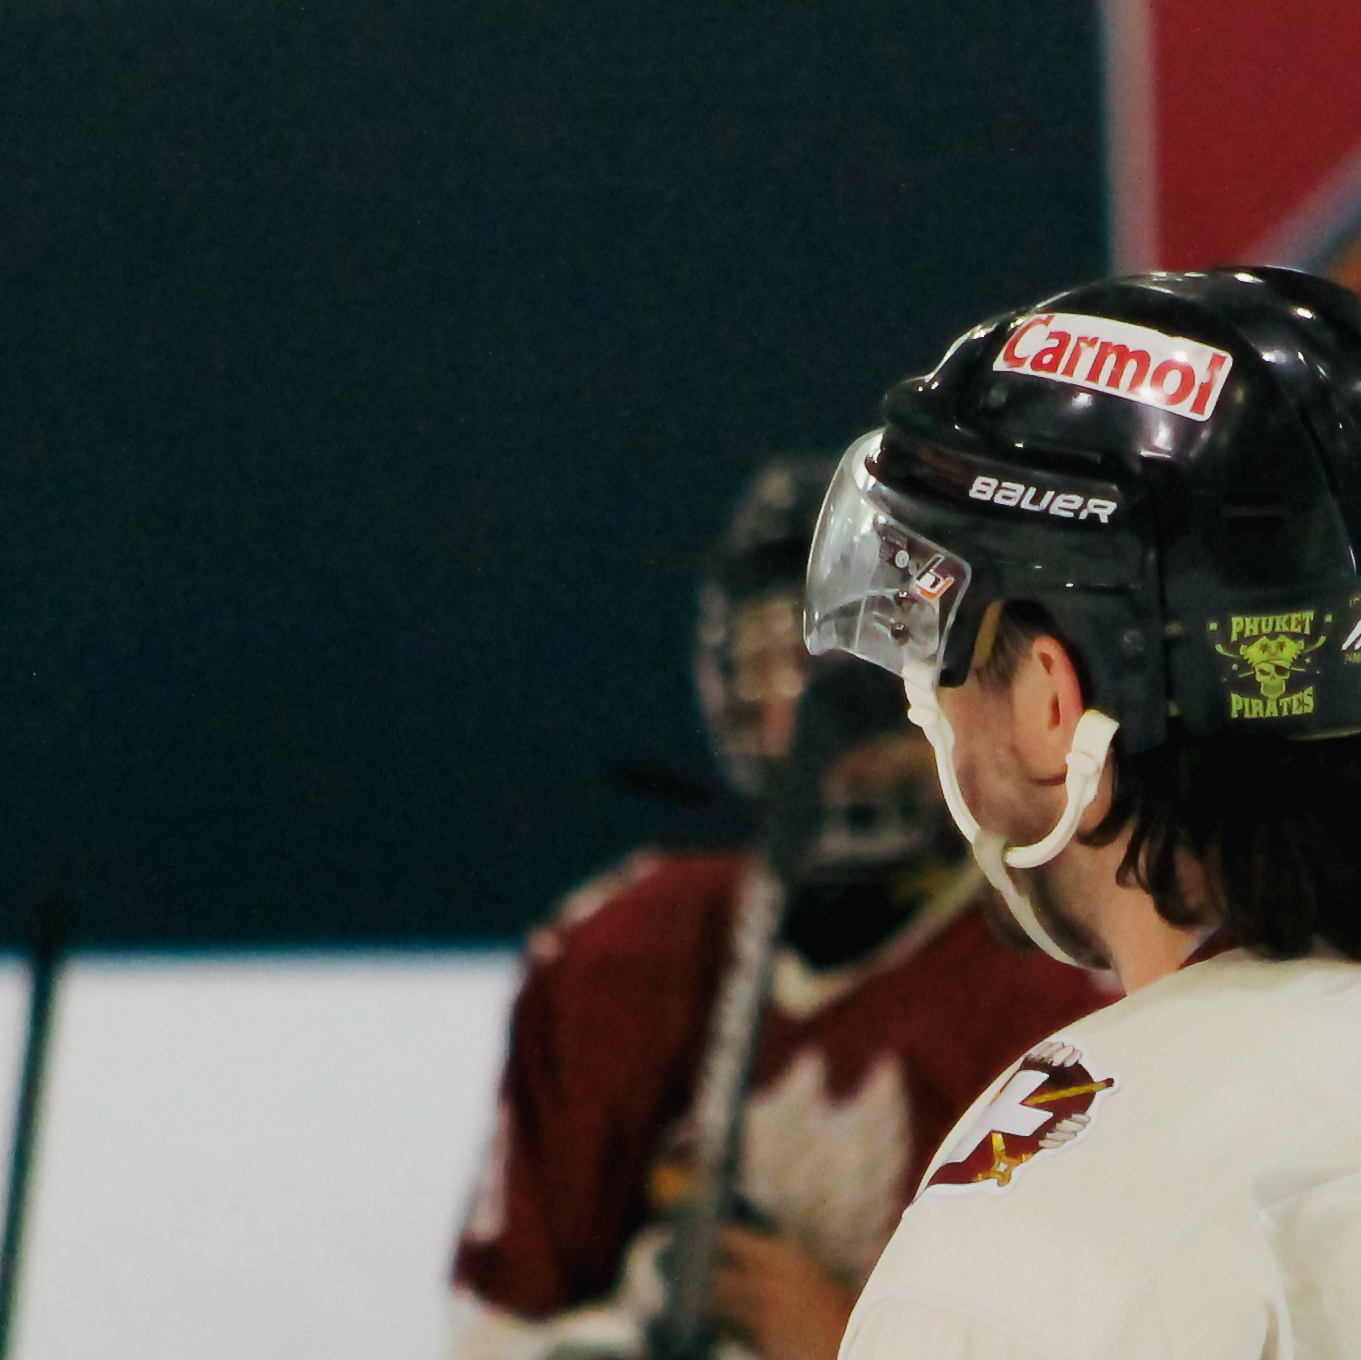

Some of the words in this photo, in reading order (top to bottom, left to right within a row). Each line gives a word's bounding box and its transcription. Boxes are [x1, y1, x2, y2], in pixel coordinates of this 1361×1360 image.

[1000, 316, 1230, 417] Carmol
[968, 476, 1117, 524] BAUER
[1230, 611, 1314, 642] PHUKET
[1230, 686, 1315, 719] PIRATES
